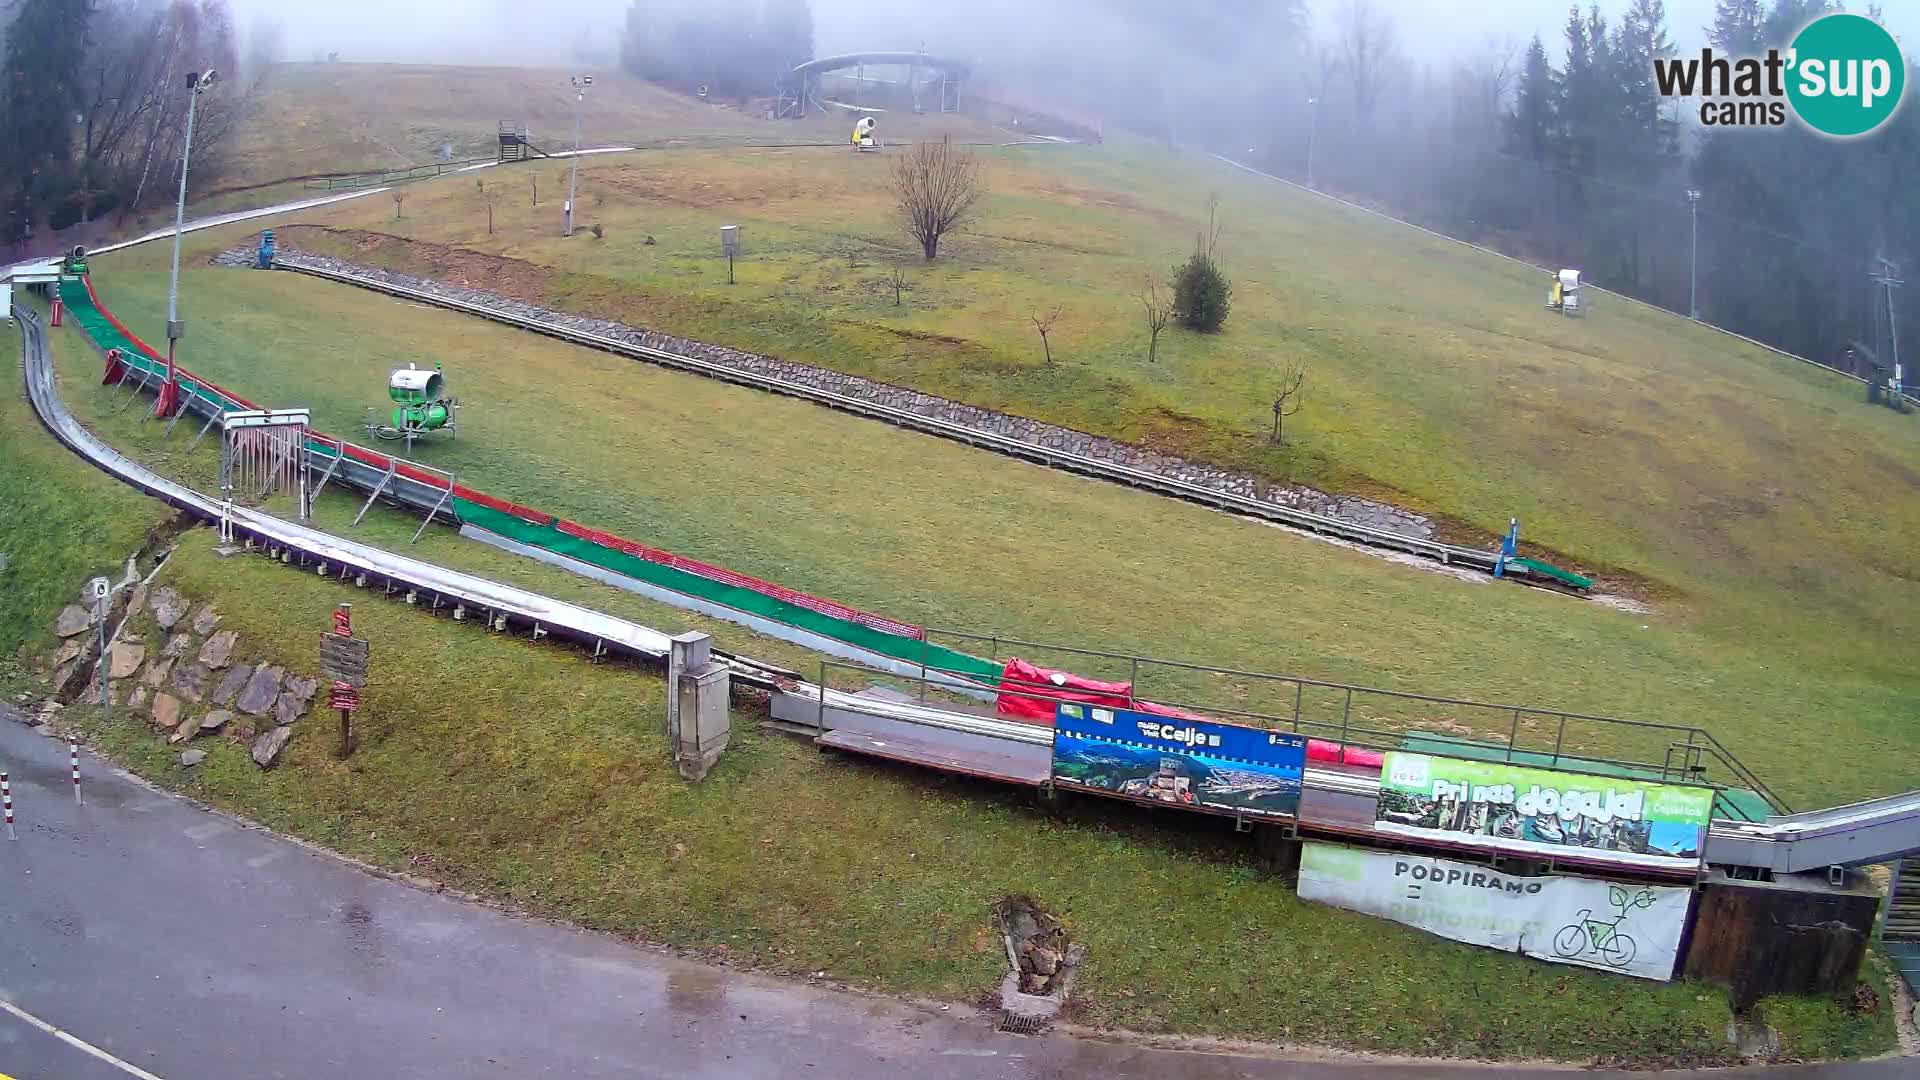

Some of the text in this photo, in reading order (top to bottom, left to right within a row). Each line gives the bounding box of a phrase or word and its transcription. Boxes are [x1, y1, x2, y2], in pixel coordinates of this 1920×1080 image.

[1160, 725, 1206, 746] Celje
[1432, 779, 1468, 802] Pri
[1474, 783, 1514, 804] nas
[1516, 784, 1645, 824] dogaja!
[1394, 861, 1543, 894] PODPIRAMO
